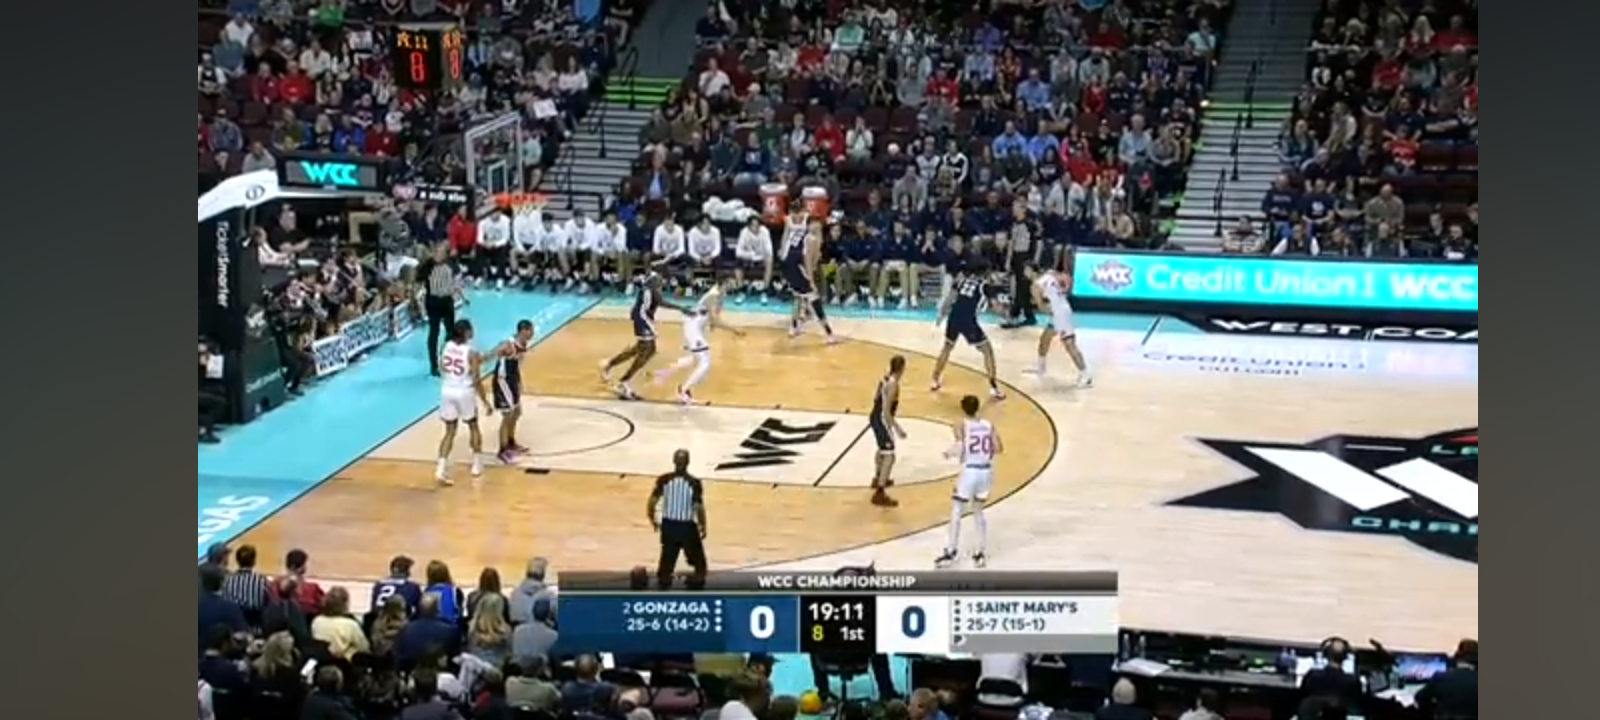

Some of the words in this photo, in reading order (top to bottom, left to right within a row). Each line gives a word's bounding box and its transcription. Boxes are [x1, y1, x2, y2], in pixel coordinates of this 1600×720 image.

[300, 161, 359, 187] WCC
[1092, 265, 1132, 285] WCC
[1146, 264, 1246, 293] Credit
[1389, 273, 1476, 299] WCC
[1210, 318, 1363, 336] WEST
[443, 355, 465, 377] 25
[713, 416, 838, 471] WCC
[969, 434, 993, 455] 20
[375, 584, 397, 607] 2
